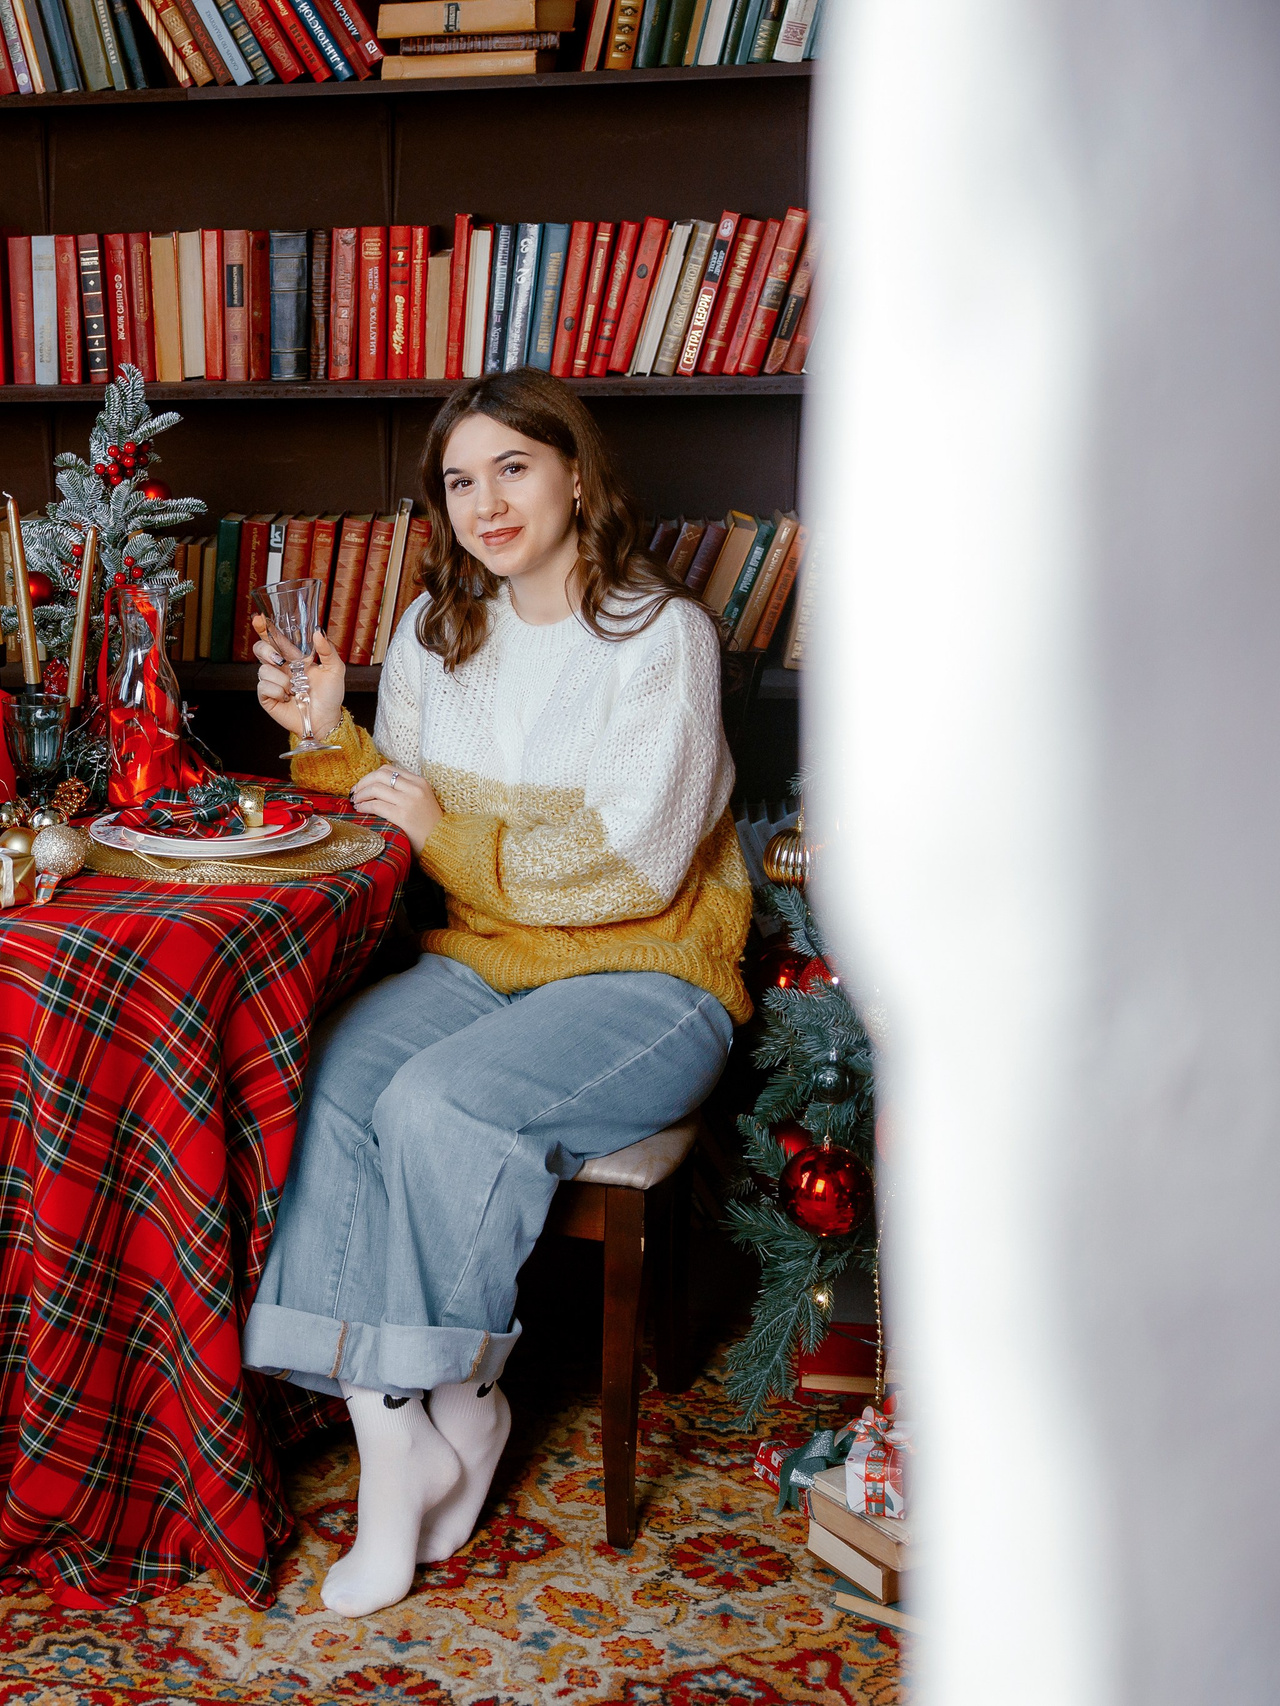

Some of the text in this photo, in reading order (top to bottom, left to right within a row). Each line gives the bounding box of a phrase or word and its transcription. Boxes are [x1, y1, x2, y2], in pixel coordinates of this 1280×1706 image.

[96, 0, 118, 64] ИНГИСХАН
[187, 12, 200, 24] О
[202, 8, 225, 40] ПЕДАГОГИКЕ
[331, 0, 360, 37] АЛЕКСАН
[189, 22, 229, 77] ФОРСАЙТАХ
[224, 48, 240, 71] СЛОВАРЬ
[396, 251, 405, 262] 2
[497, 230, 510, 266] ПОЛИНА
[536, 249, 562, 353] СВЯЩЕННАЯ ВОЙНА
[682, 292, 711, 366] СЕСТРА КЕРРИ
